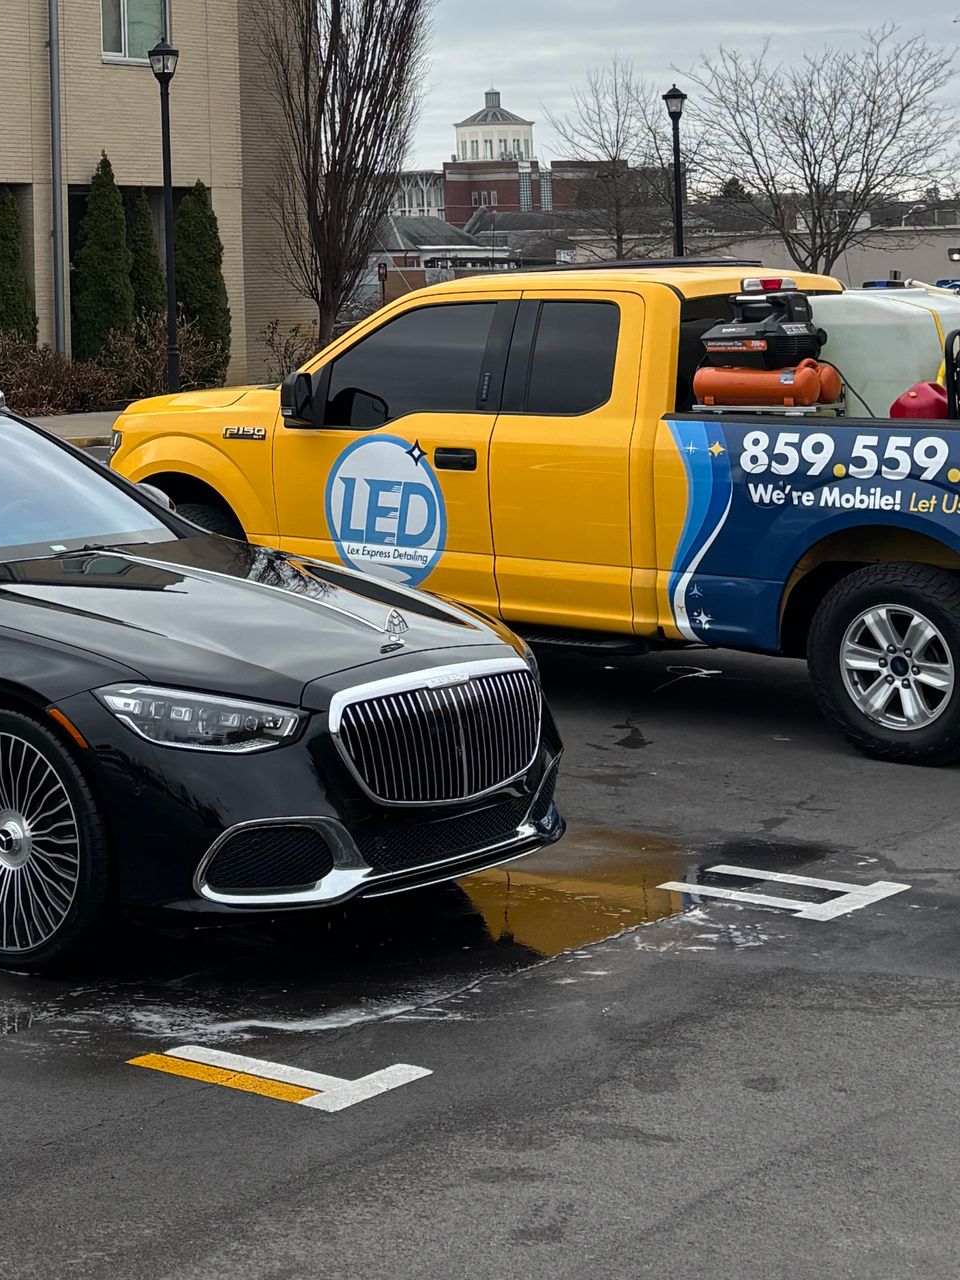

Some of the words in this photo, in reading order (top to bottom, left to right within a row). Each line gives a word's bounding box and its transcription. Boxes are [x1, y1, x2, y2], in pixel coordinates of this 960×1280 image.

[339, 476, 437, 548] LED
[748, 482, 815, 506] We're
[819, 486, 902, 511] Mobile!
[909, 492, 937, 513] Let
[347, 544, 360, 556] Lex
[361, 545, 391, 560] Express
[393, 548, 429, 565] Detailing
